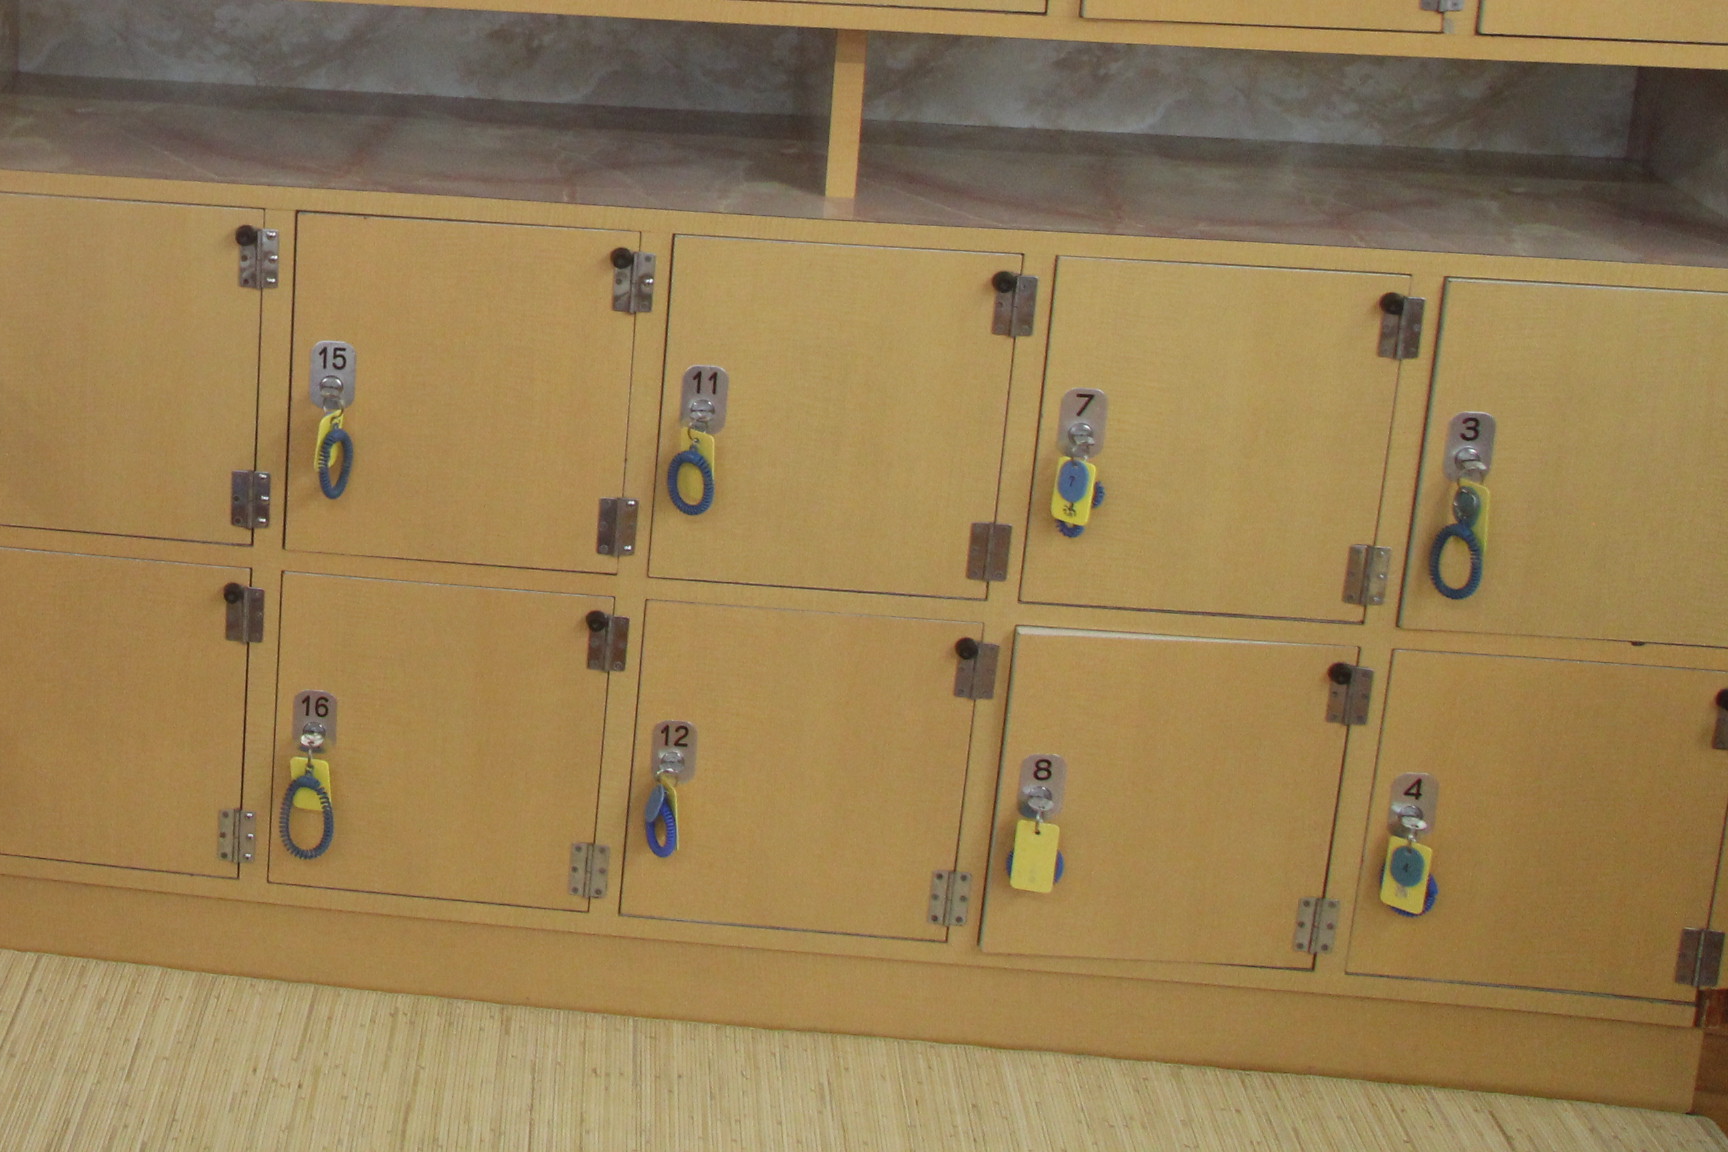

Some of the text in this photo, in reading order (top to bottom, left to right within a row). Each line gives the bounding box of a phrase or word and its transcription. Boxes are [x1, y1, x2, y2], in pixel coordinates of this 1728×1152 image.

[318, 348, 347, 370] 15
[693, 372, 718, 395] 11
[1075, 394, 1095, 416] 7
[1460, 418, 1479, 441] 3
[301, 697, 329, 718] 16
[661, 727, 688, 747] 12
[1032, 759, 1052, 780] 8
[1403, 778, 1423, 800] 4
